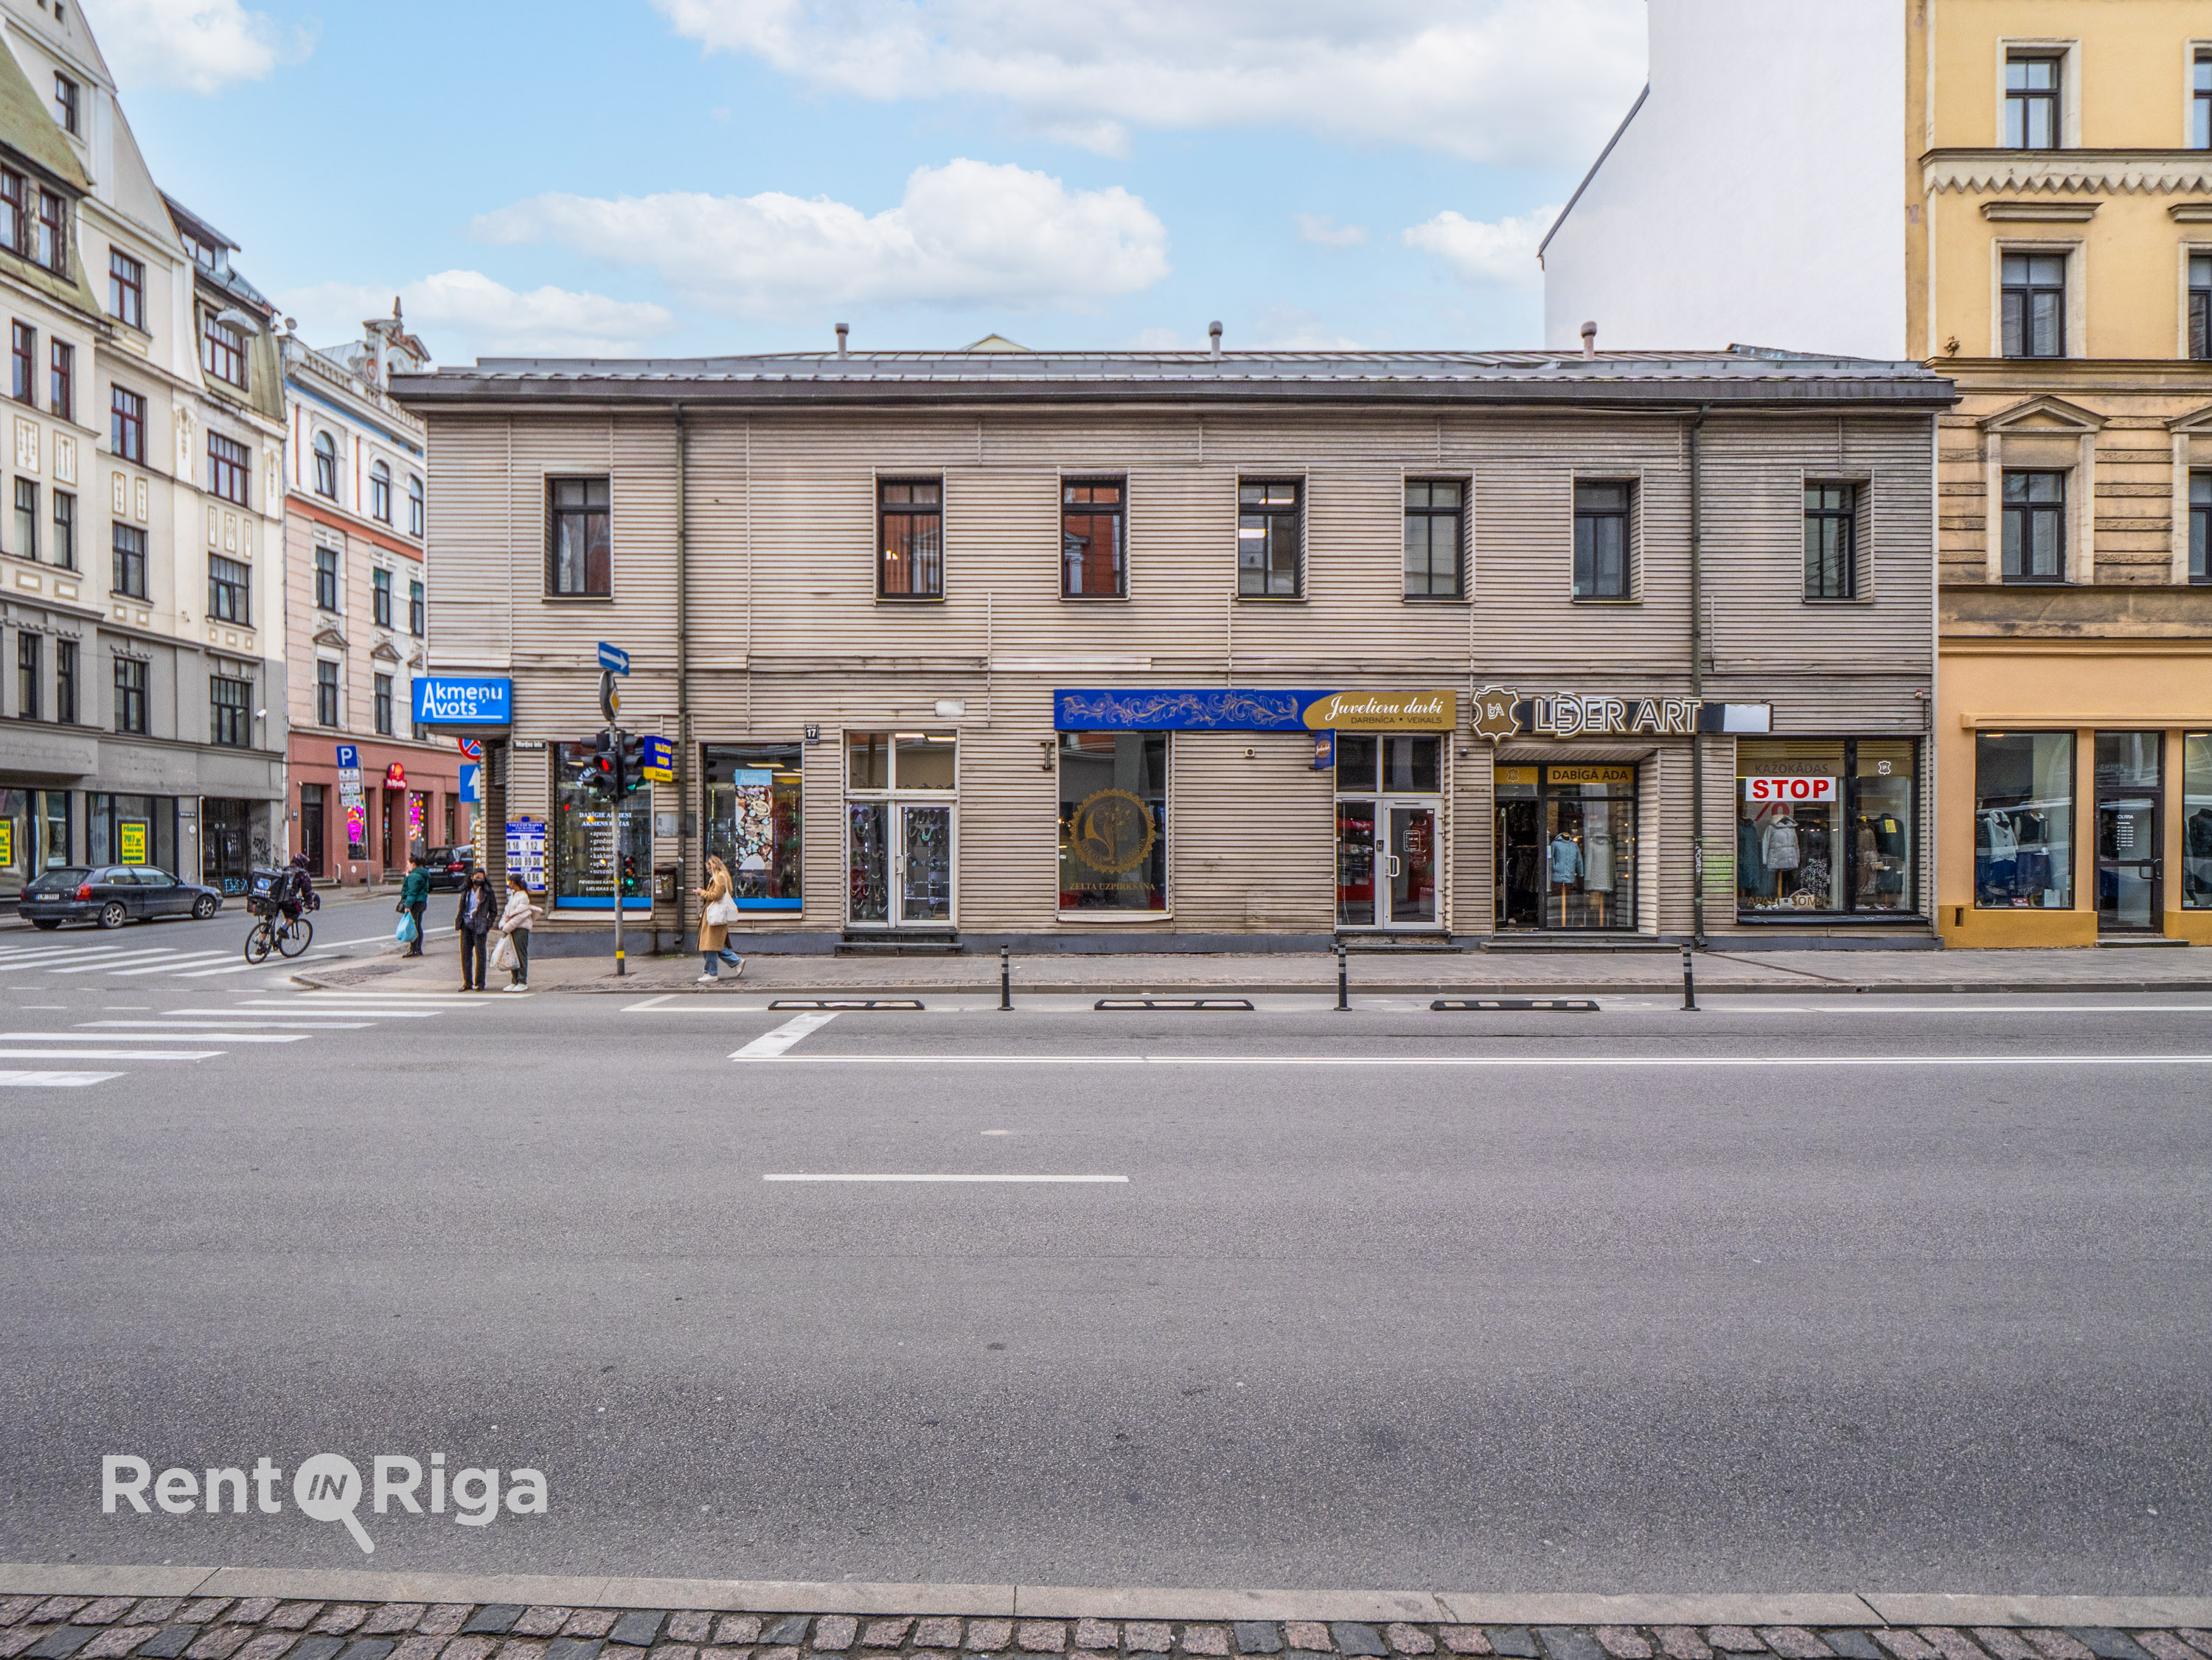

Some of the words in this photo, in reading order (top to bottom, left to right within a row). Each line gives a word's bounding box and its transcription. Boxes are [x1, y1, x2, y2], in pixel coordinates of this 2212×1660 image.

[422, 682, 503, 714] Akmeņu
[1325, 696, 1400, 721] Juvelieru
[1403, 697, 1444, 714] darbi
[1631, 697, 1703, 732] ART
[1351, 716, 1395, 724] DARBNĪCA
[807, 728, 816, 738] 17
[341, 747, 352, 765] P
[1553, 767, 1601, 780] DABĪGĀ
[1602, 767, 1628, 780] ĀDA
[1755, 762, 1829, 773] KAŽOKĀDAS
[1753, 780, 1829, 798] STOP
[1070, 882, 1097, 890] ZELTA
